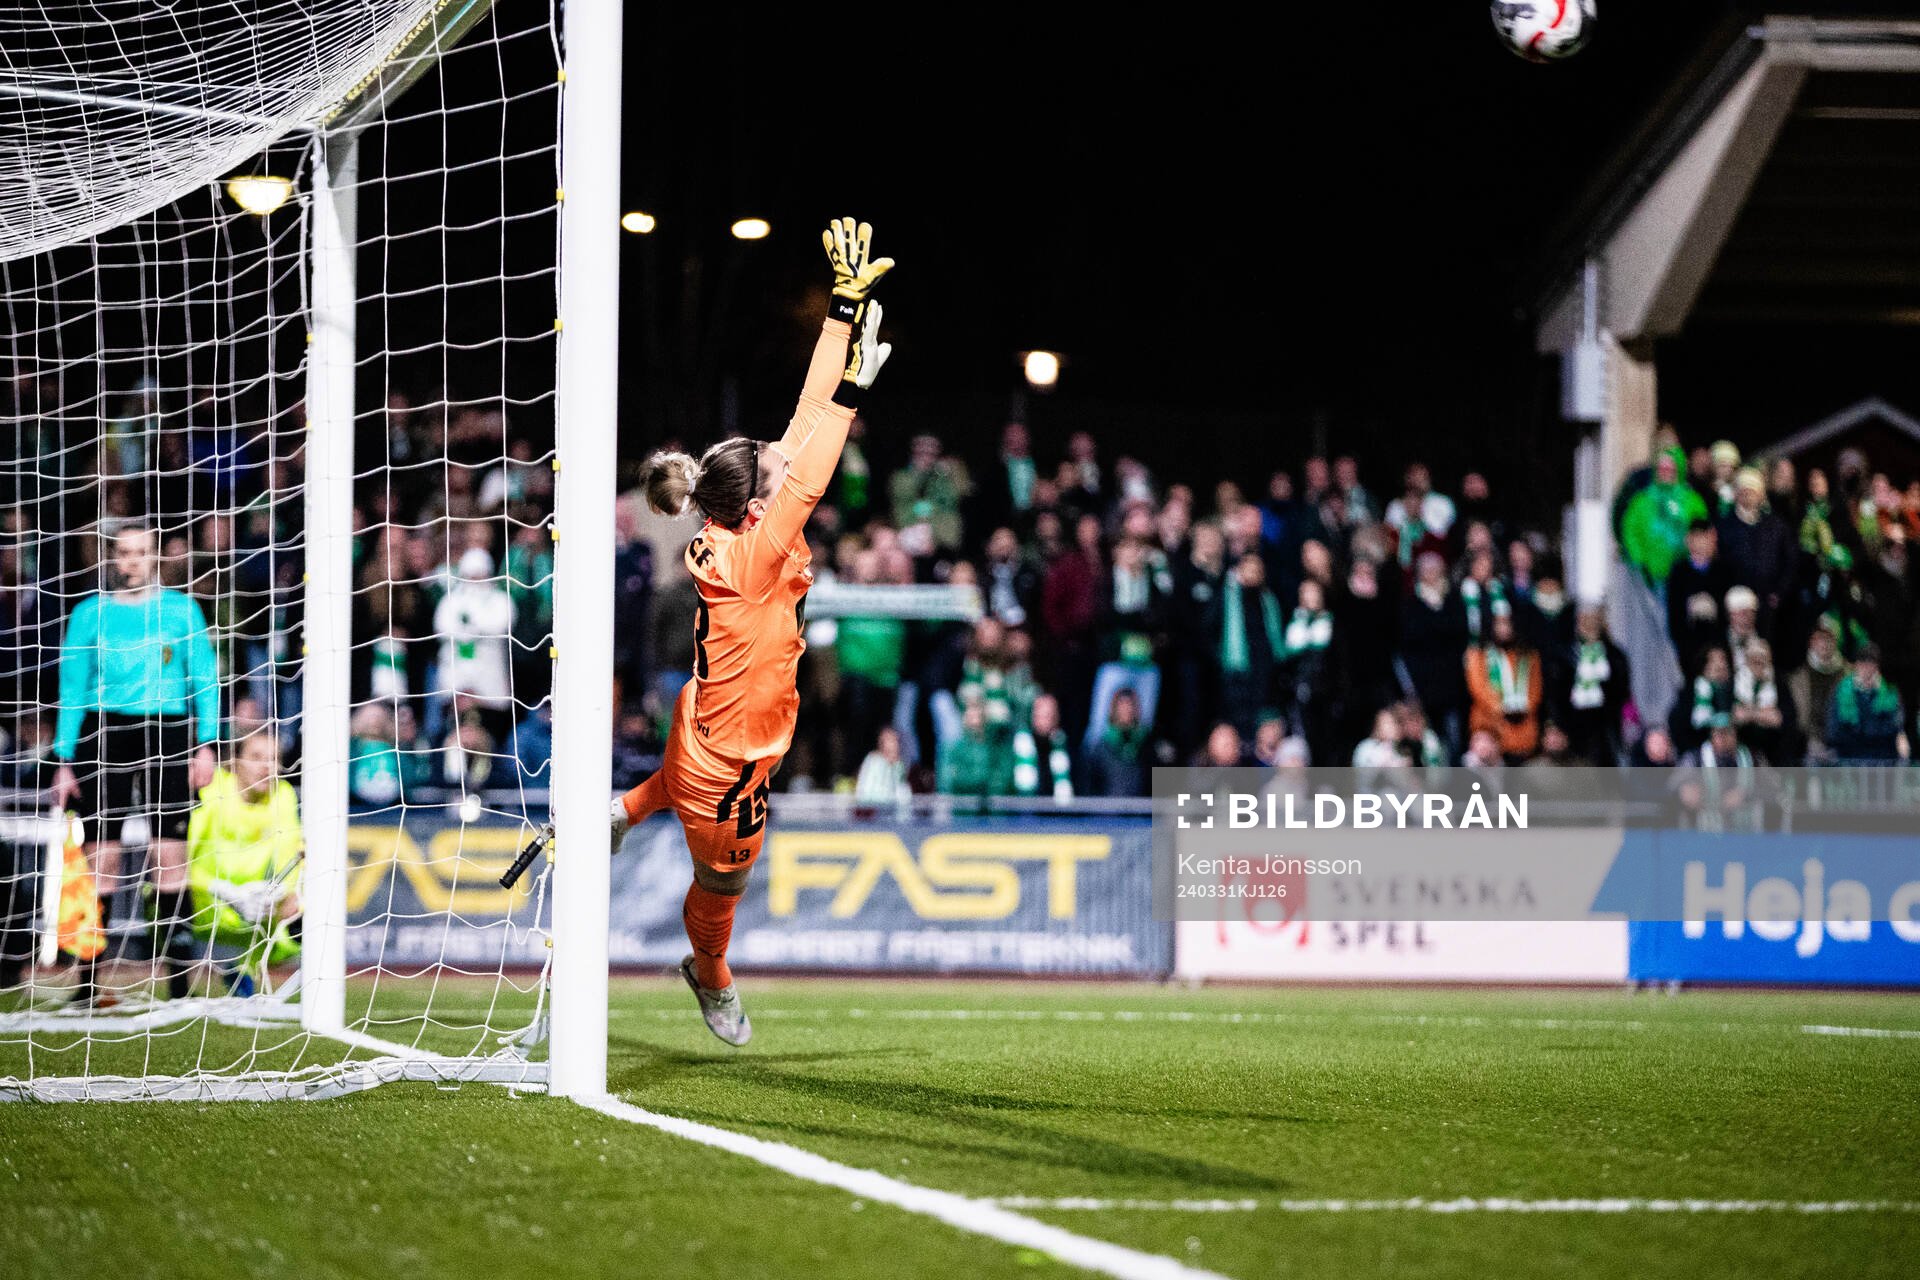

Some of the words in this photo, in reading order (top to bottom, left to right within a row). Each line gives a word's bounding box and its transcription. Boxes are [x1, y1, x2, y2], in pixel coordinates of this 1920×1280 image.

[728, 849, 750, 863] 13
[769, 831, 1112, 919] FAST
[1330, 875, 1537, 908] SVENSKA
[1682, 857, 1872, 958] Heja
[1330, 918, 1434, 950] SPEL
